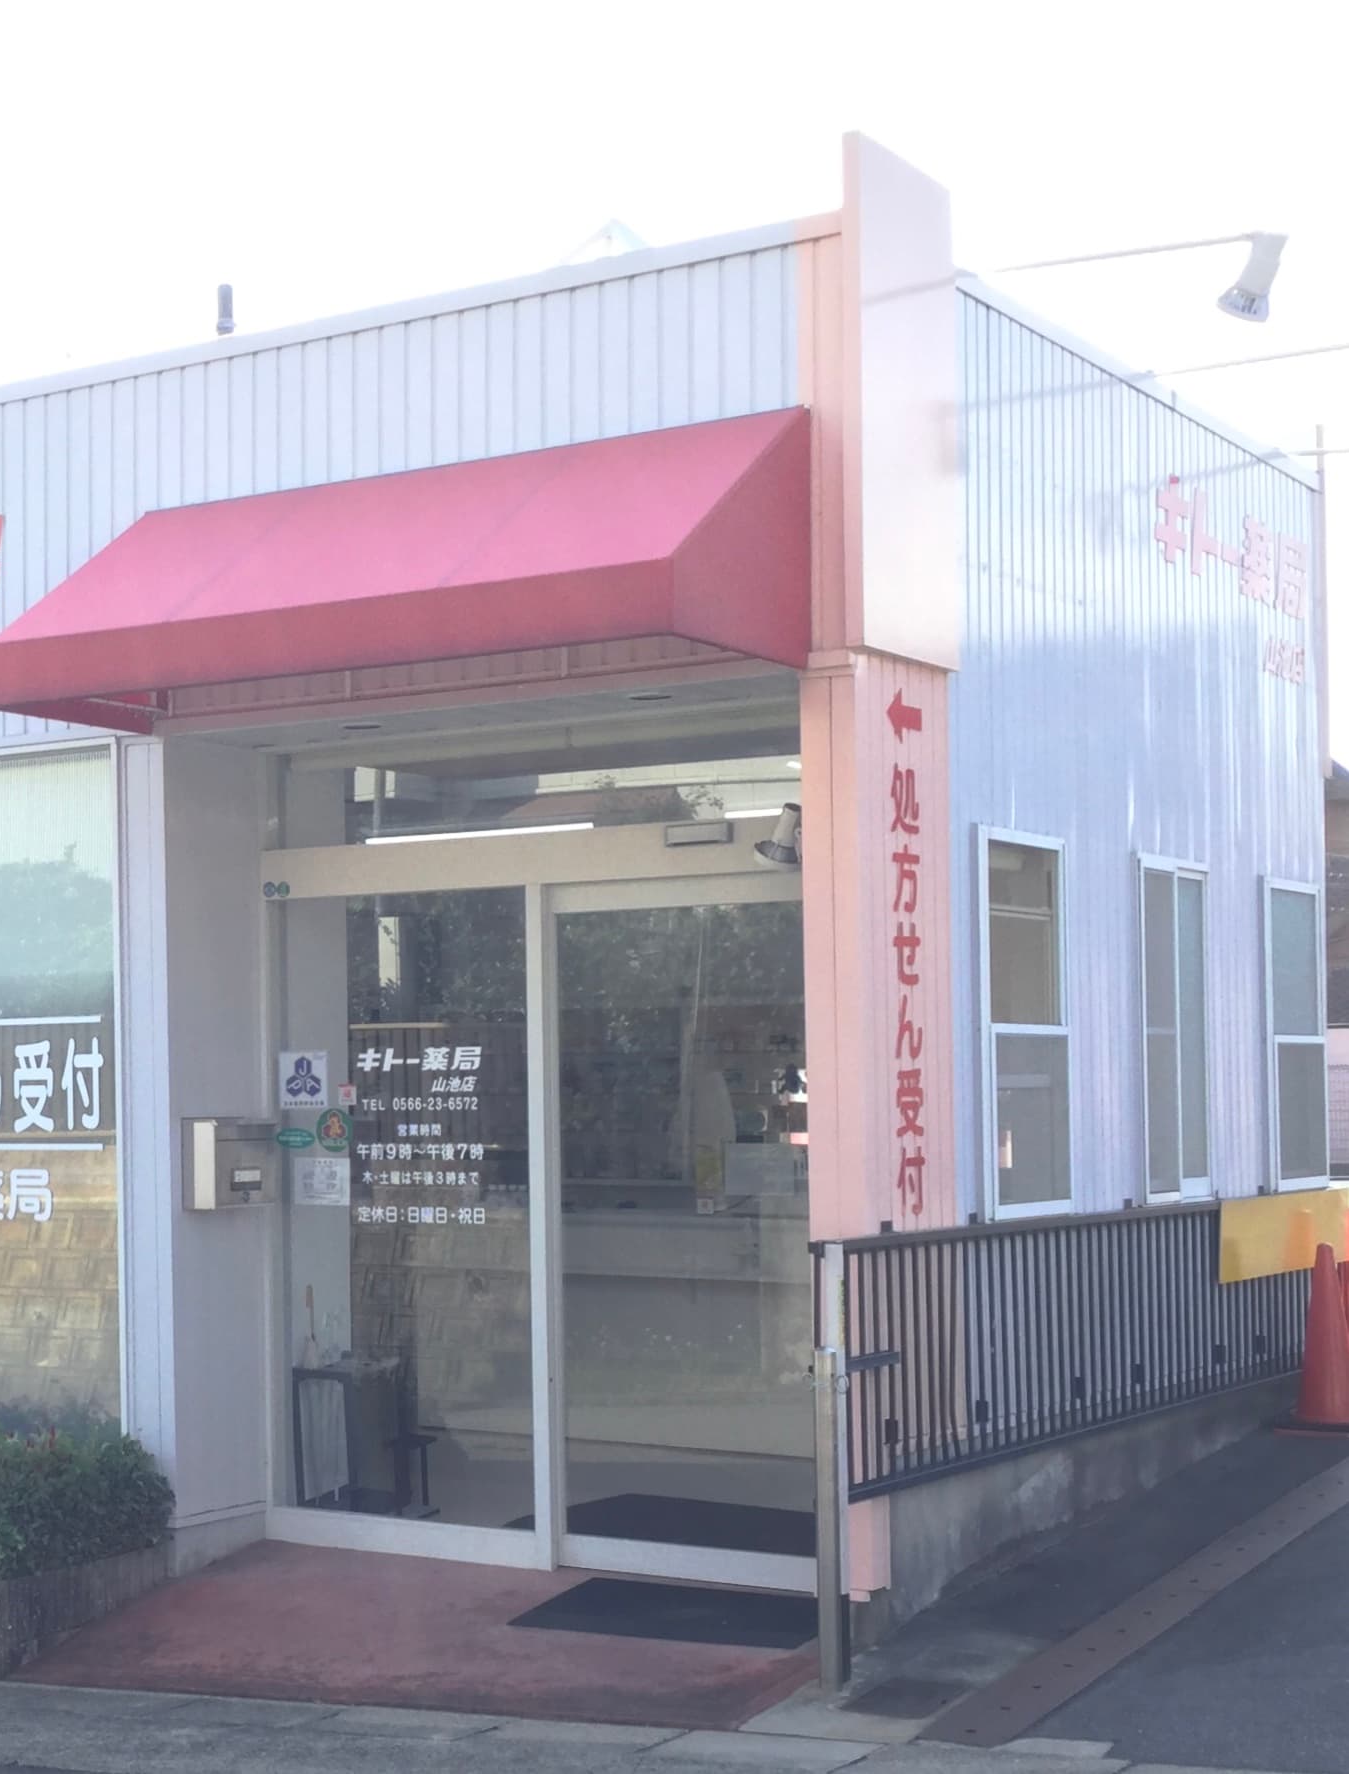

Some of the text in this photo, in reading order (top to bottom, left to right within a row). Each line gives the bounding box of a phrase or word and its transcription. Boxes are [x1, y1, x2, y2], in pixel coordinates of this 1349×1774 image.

[889, 762, 926, 1217] 処方せん受付
[356, 1046, 482, 1072] キトー薬局
[431, 1076, 477, 1093] 山池店
[361, 1097, 479, 1111] TEL 0566-23-6572
[397, 1123, 442, 1137] 営業時間
